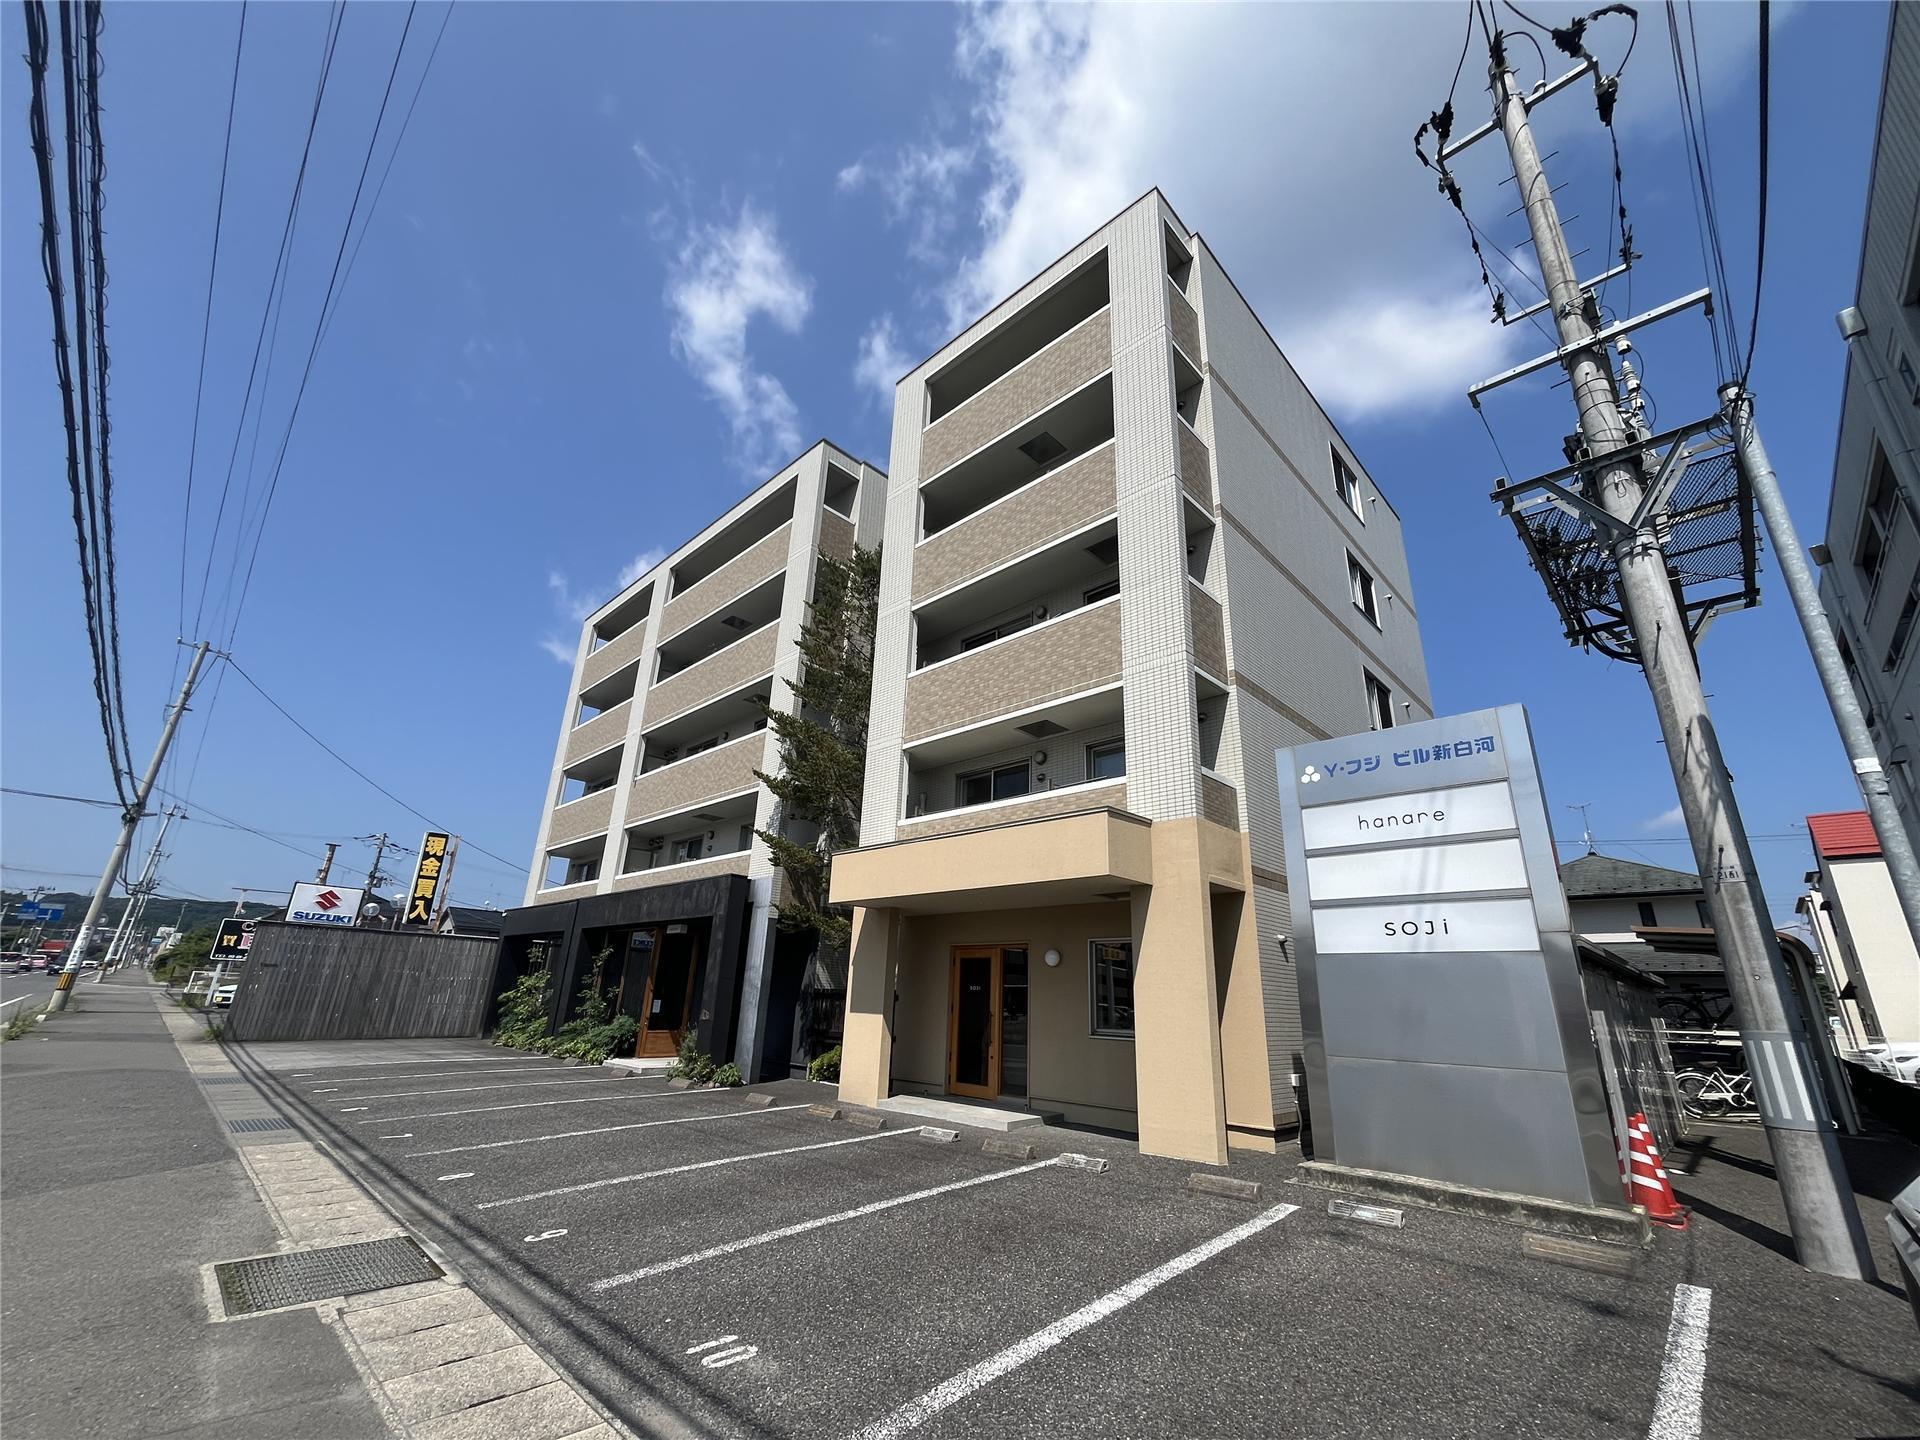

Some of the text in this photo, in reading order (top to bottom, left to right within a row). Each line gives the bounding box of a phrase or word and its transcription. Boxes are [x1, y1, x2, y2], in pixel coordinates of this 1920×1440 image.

[1393, 735, 1495, 767] ビル新白河
[1358, 810, 1445, 831] hanare
[409, 836, 446, 921] 現金買入
[293, 911, 353, 924] SUZUKI
[685, 1335, 759, 1369] 10
